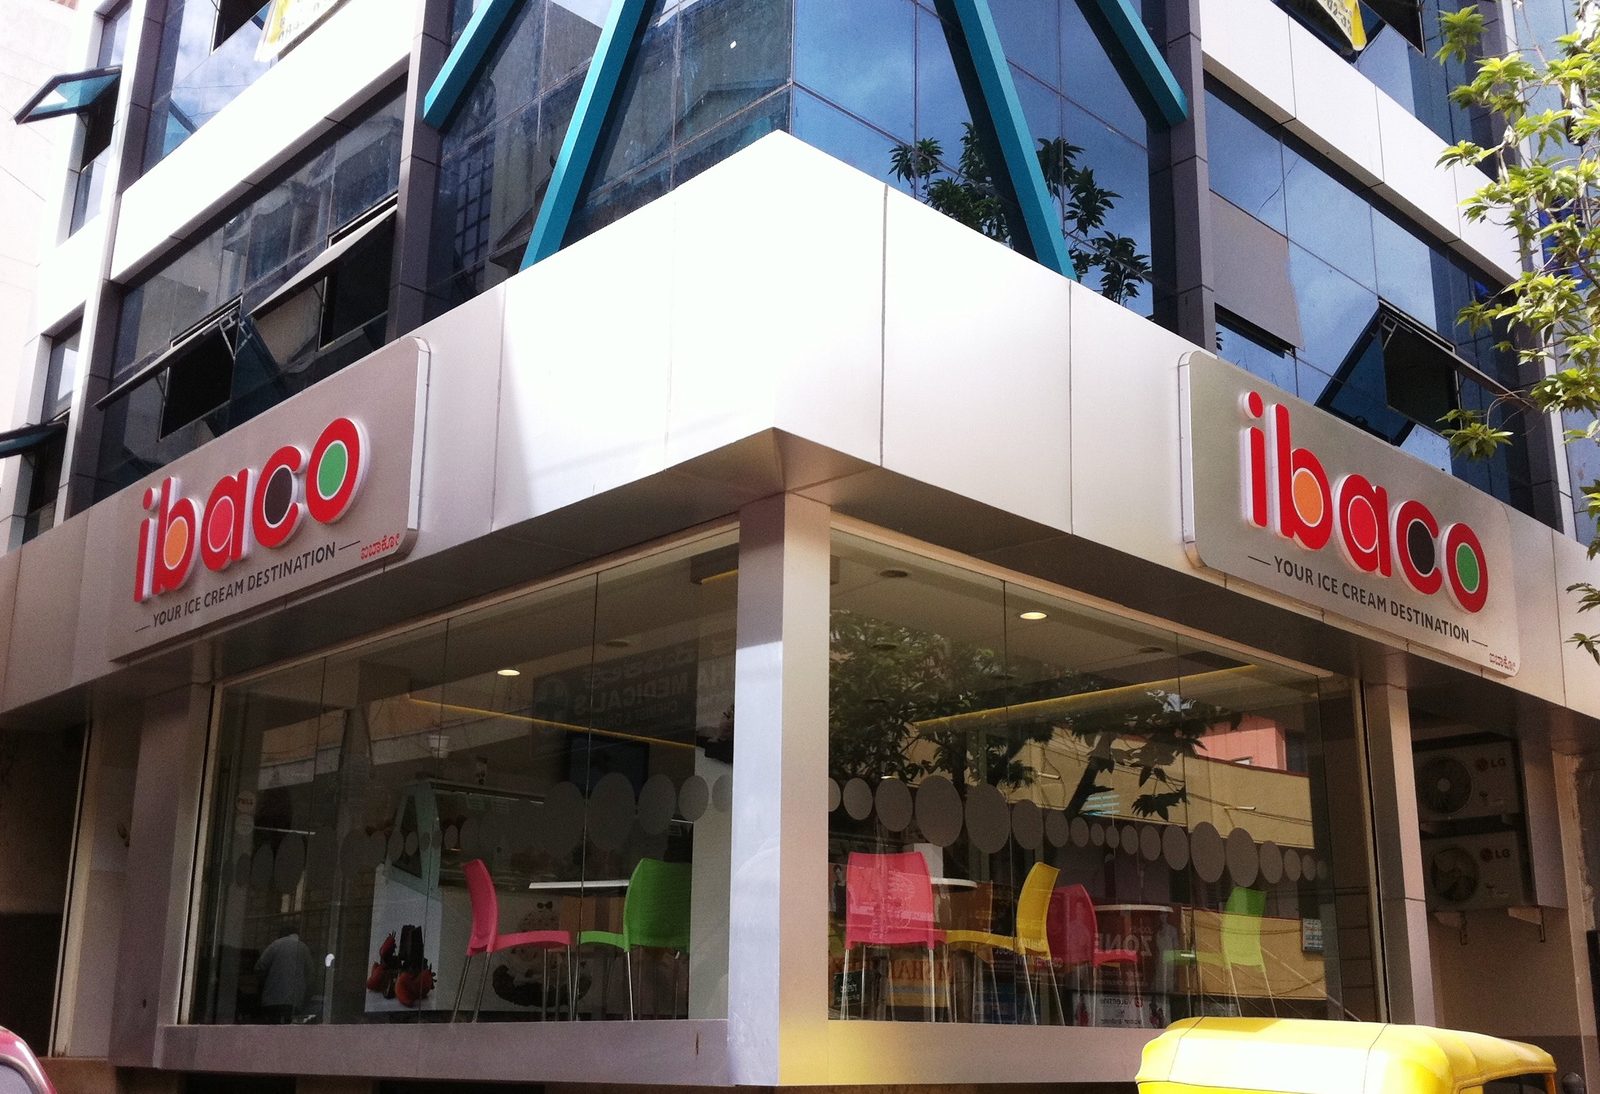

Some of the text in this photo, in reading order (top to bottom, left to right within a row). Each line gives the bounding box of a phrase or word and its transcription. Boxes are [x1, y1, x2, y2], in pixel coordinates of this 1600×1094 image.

[134, 416, 367, 603] ibaco
[1242, 390, 1489, 614] ibaco
[153, 541, 336, 628] YOUR ICE CREAM DESTINATION
[1274, 555, 1470, 644] YOUR ICE CREAM DESTINATION
